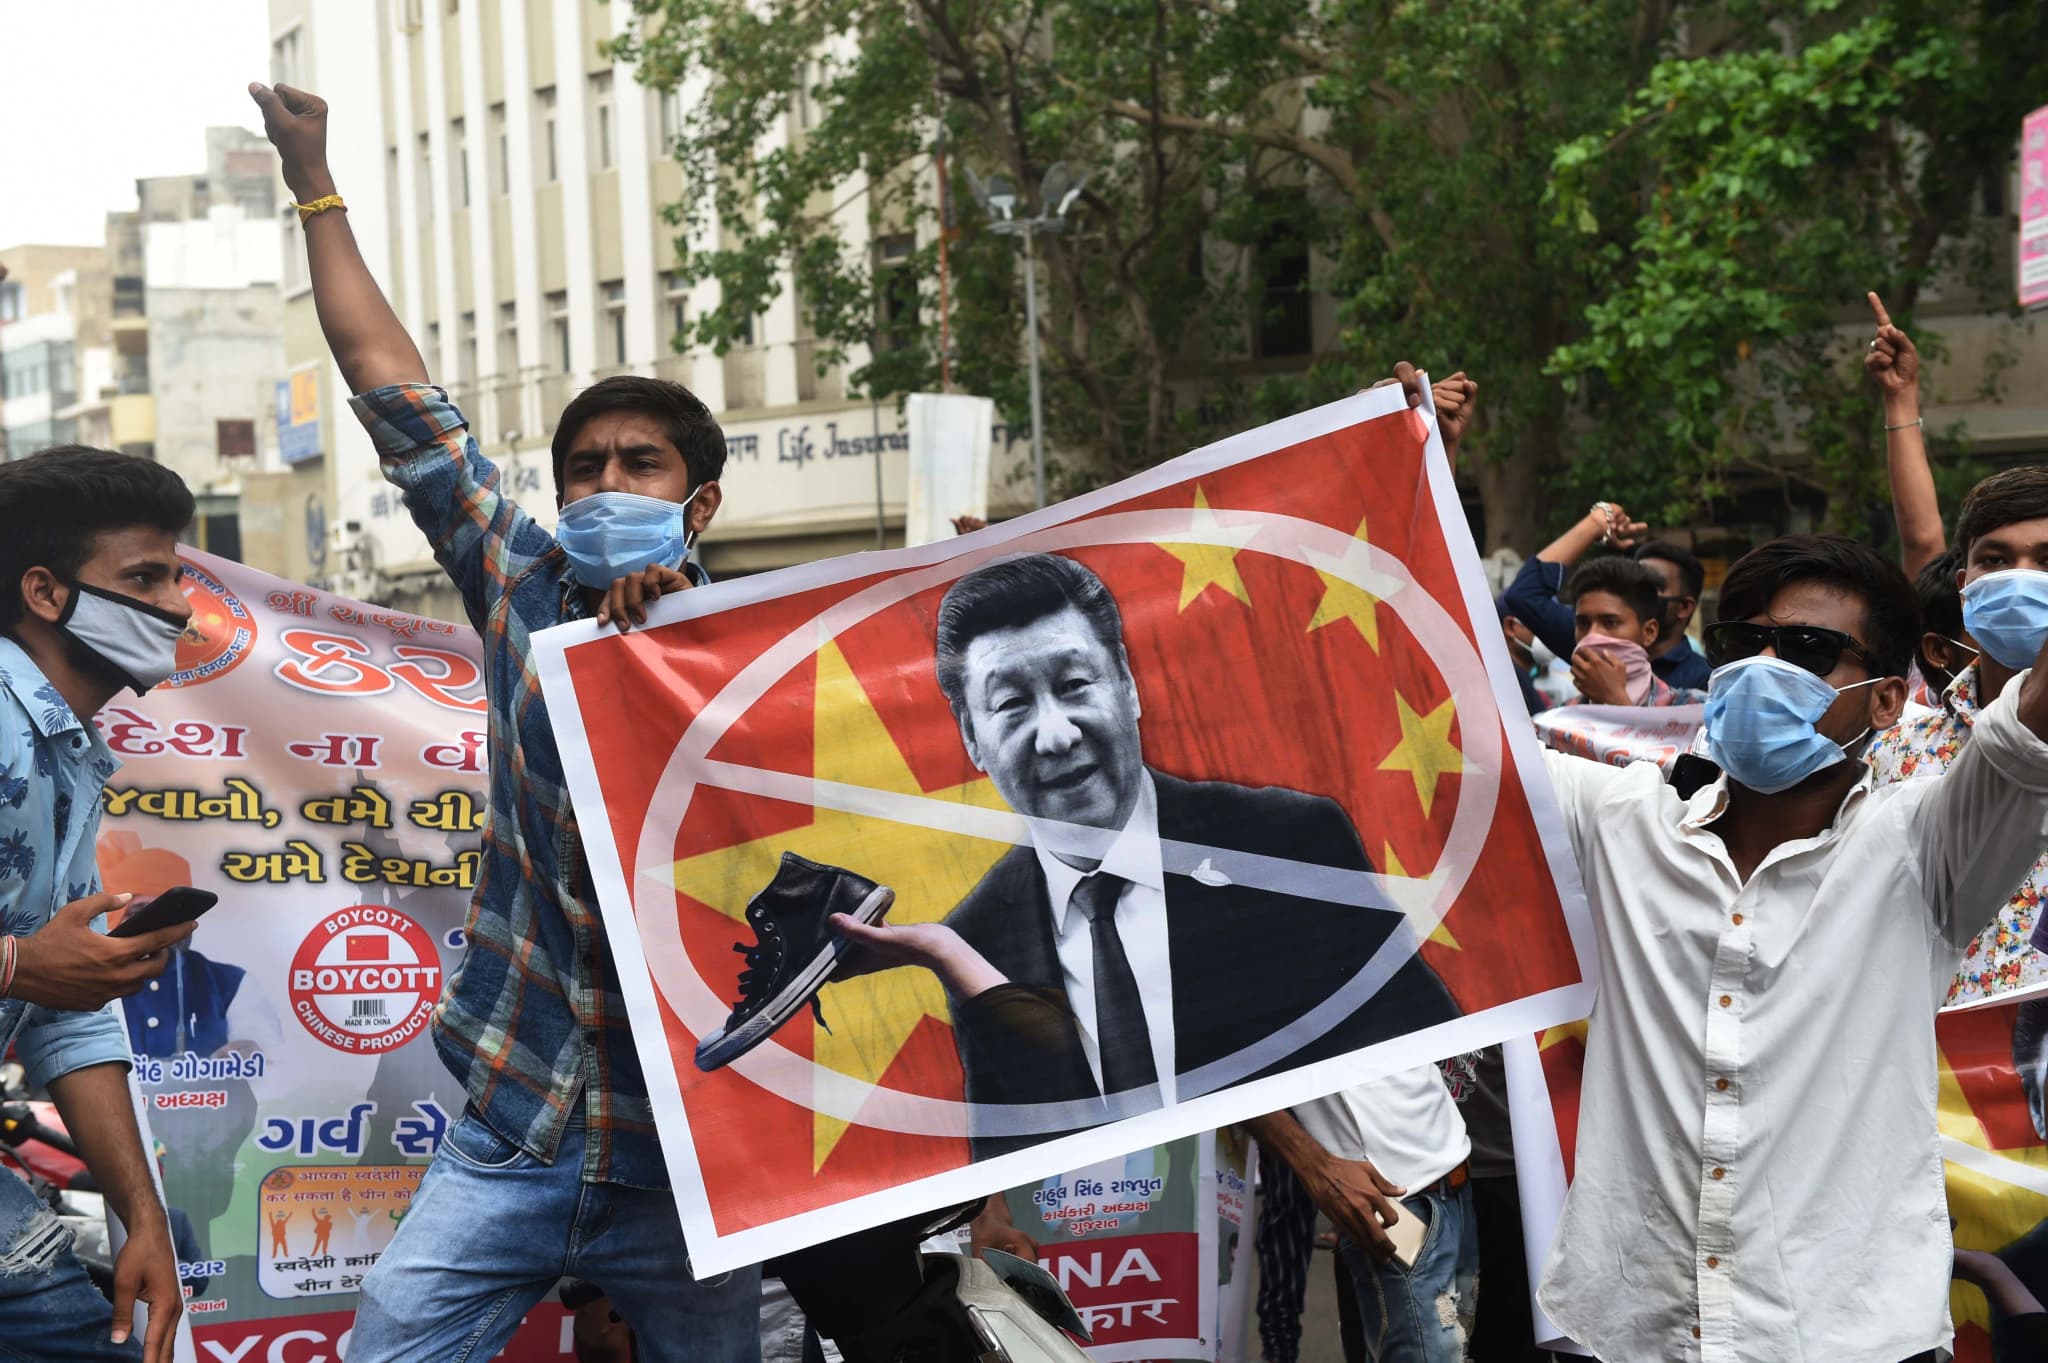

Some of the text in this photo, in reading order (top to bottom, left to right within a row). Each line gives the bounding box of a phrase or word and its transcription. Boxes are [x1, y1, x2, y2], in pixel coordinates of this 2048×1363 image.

[778, 422, 910, 469] Life Insura
[288, 734, 380, 767] ના
[302, 786, 391, 829] તમે
[223, 841, 325, 884] અમે
[325, 908, 413, 935] BOYCOTT
[293, 967, 440, 991] BOYCOTT
[297, 999, 433, 1050] CHINESE PRODUCTS
[344, 1019, 363, 1027] MADE
[373, 1018, 391, 1026] CHINA
[257, 1102, 374, 1154] ગર્વ
[300, 1170, 348, 1182] आपका
[355, 1167, 402, 1183] स्वदेशी
[265, 1193, 288, 1203] कर
[294, 1191, 335, 1203] सकता
[341, 1187, 351, 1202] है
[359, 1189, 386, 1200] चीन
[1074, 1179, 1104, 1198] સિંહ
[1071, 1218, 1119, 1235] ગુજરાત
[273, 1255, 337, 1273] स्वदेशी
[294, 1279, 333, 1292] चीन
